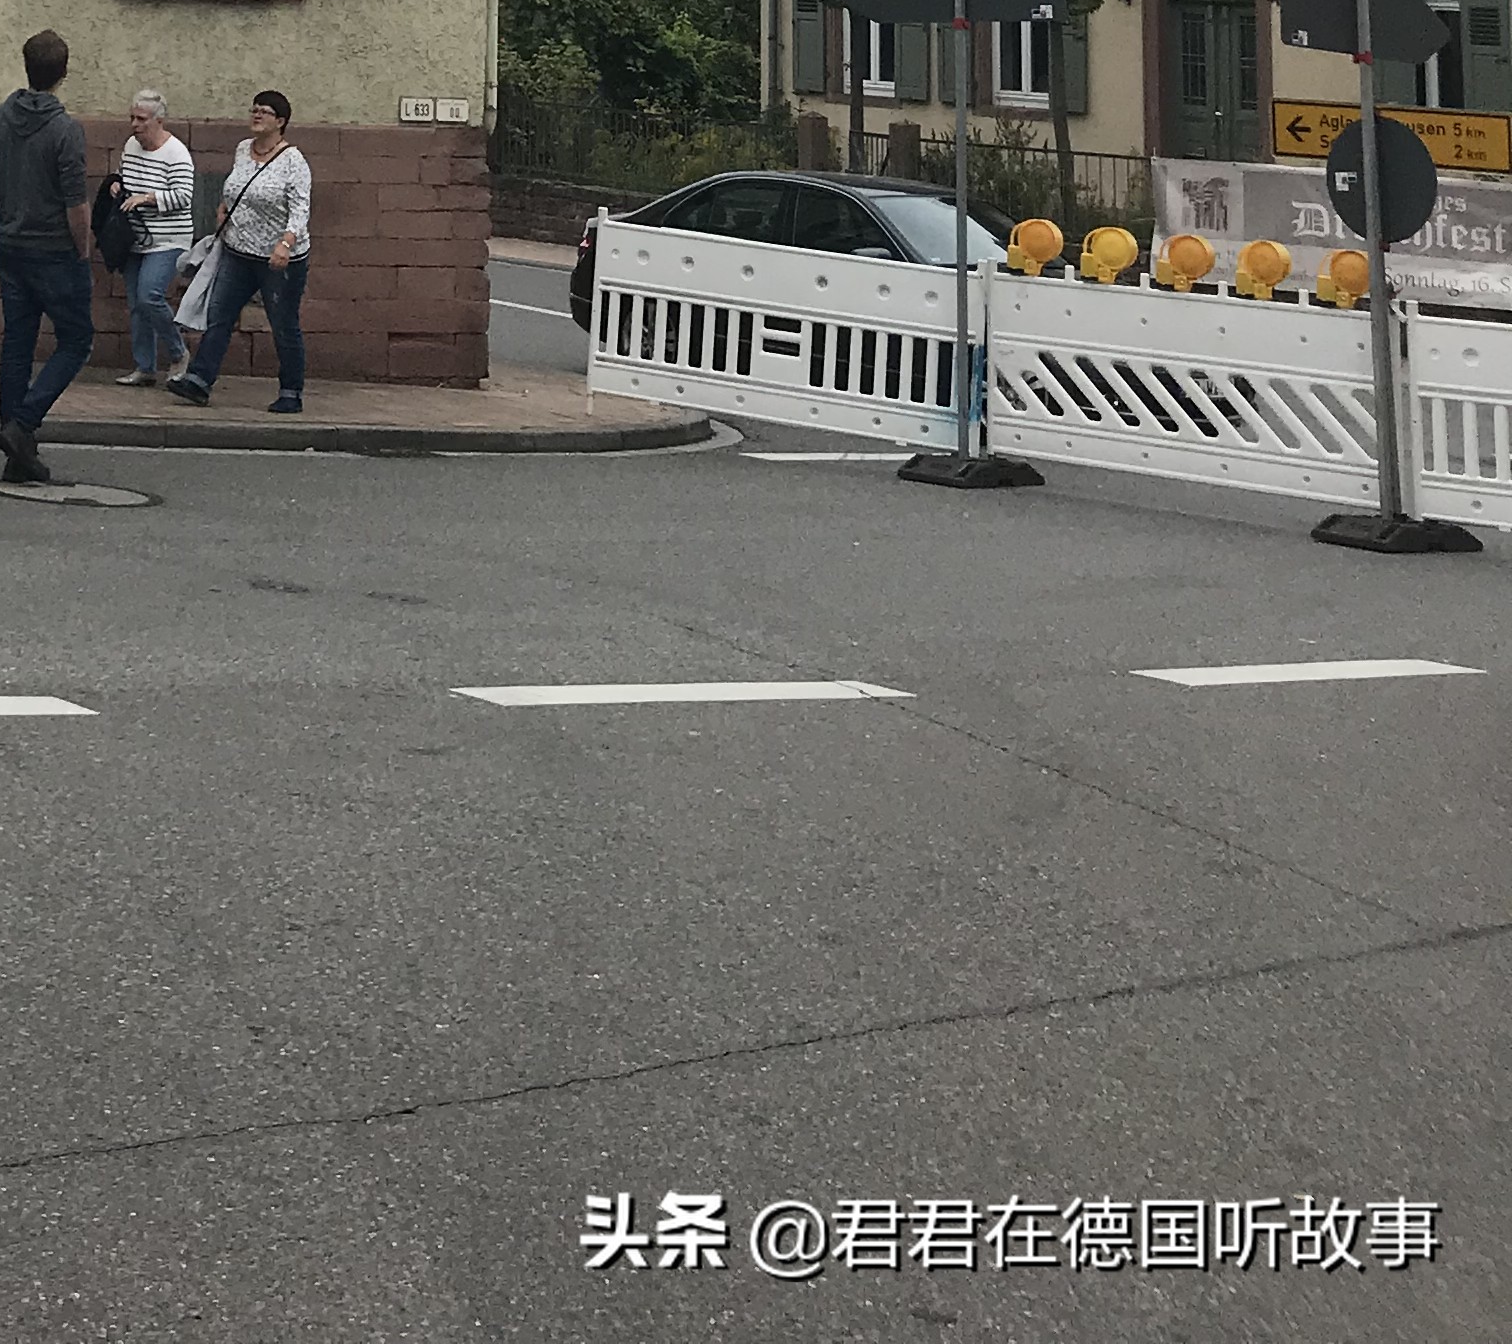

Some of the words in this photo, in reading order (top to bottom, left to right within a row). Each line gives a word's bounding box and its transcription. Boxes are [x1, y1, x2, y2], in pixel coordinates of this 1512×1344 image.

[1453, 123, 1463, 136] 5
[1465, 126, 1487, 140] km
[1454, 145, 1464, 160] 2
[1466, 148, 1488, 161] km
